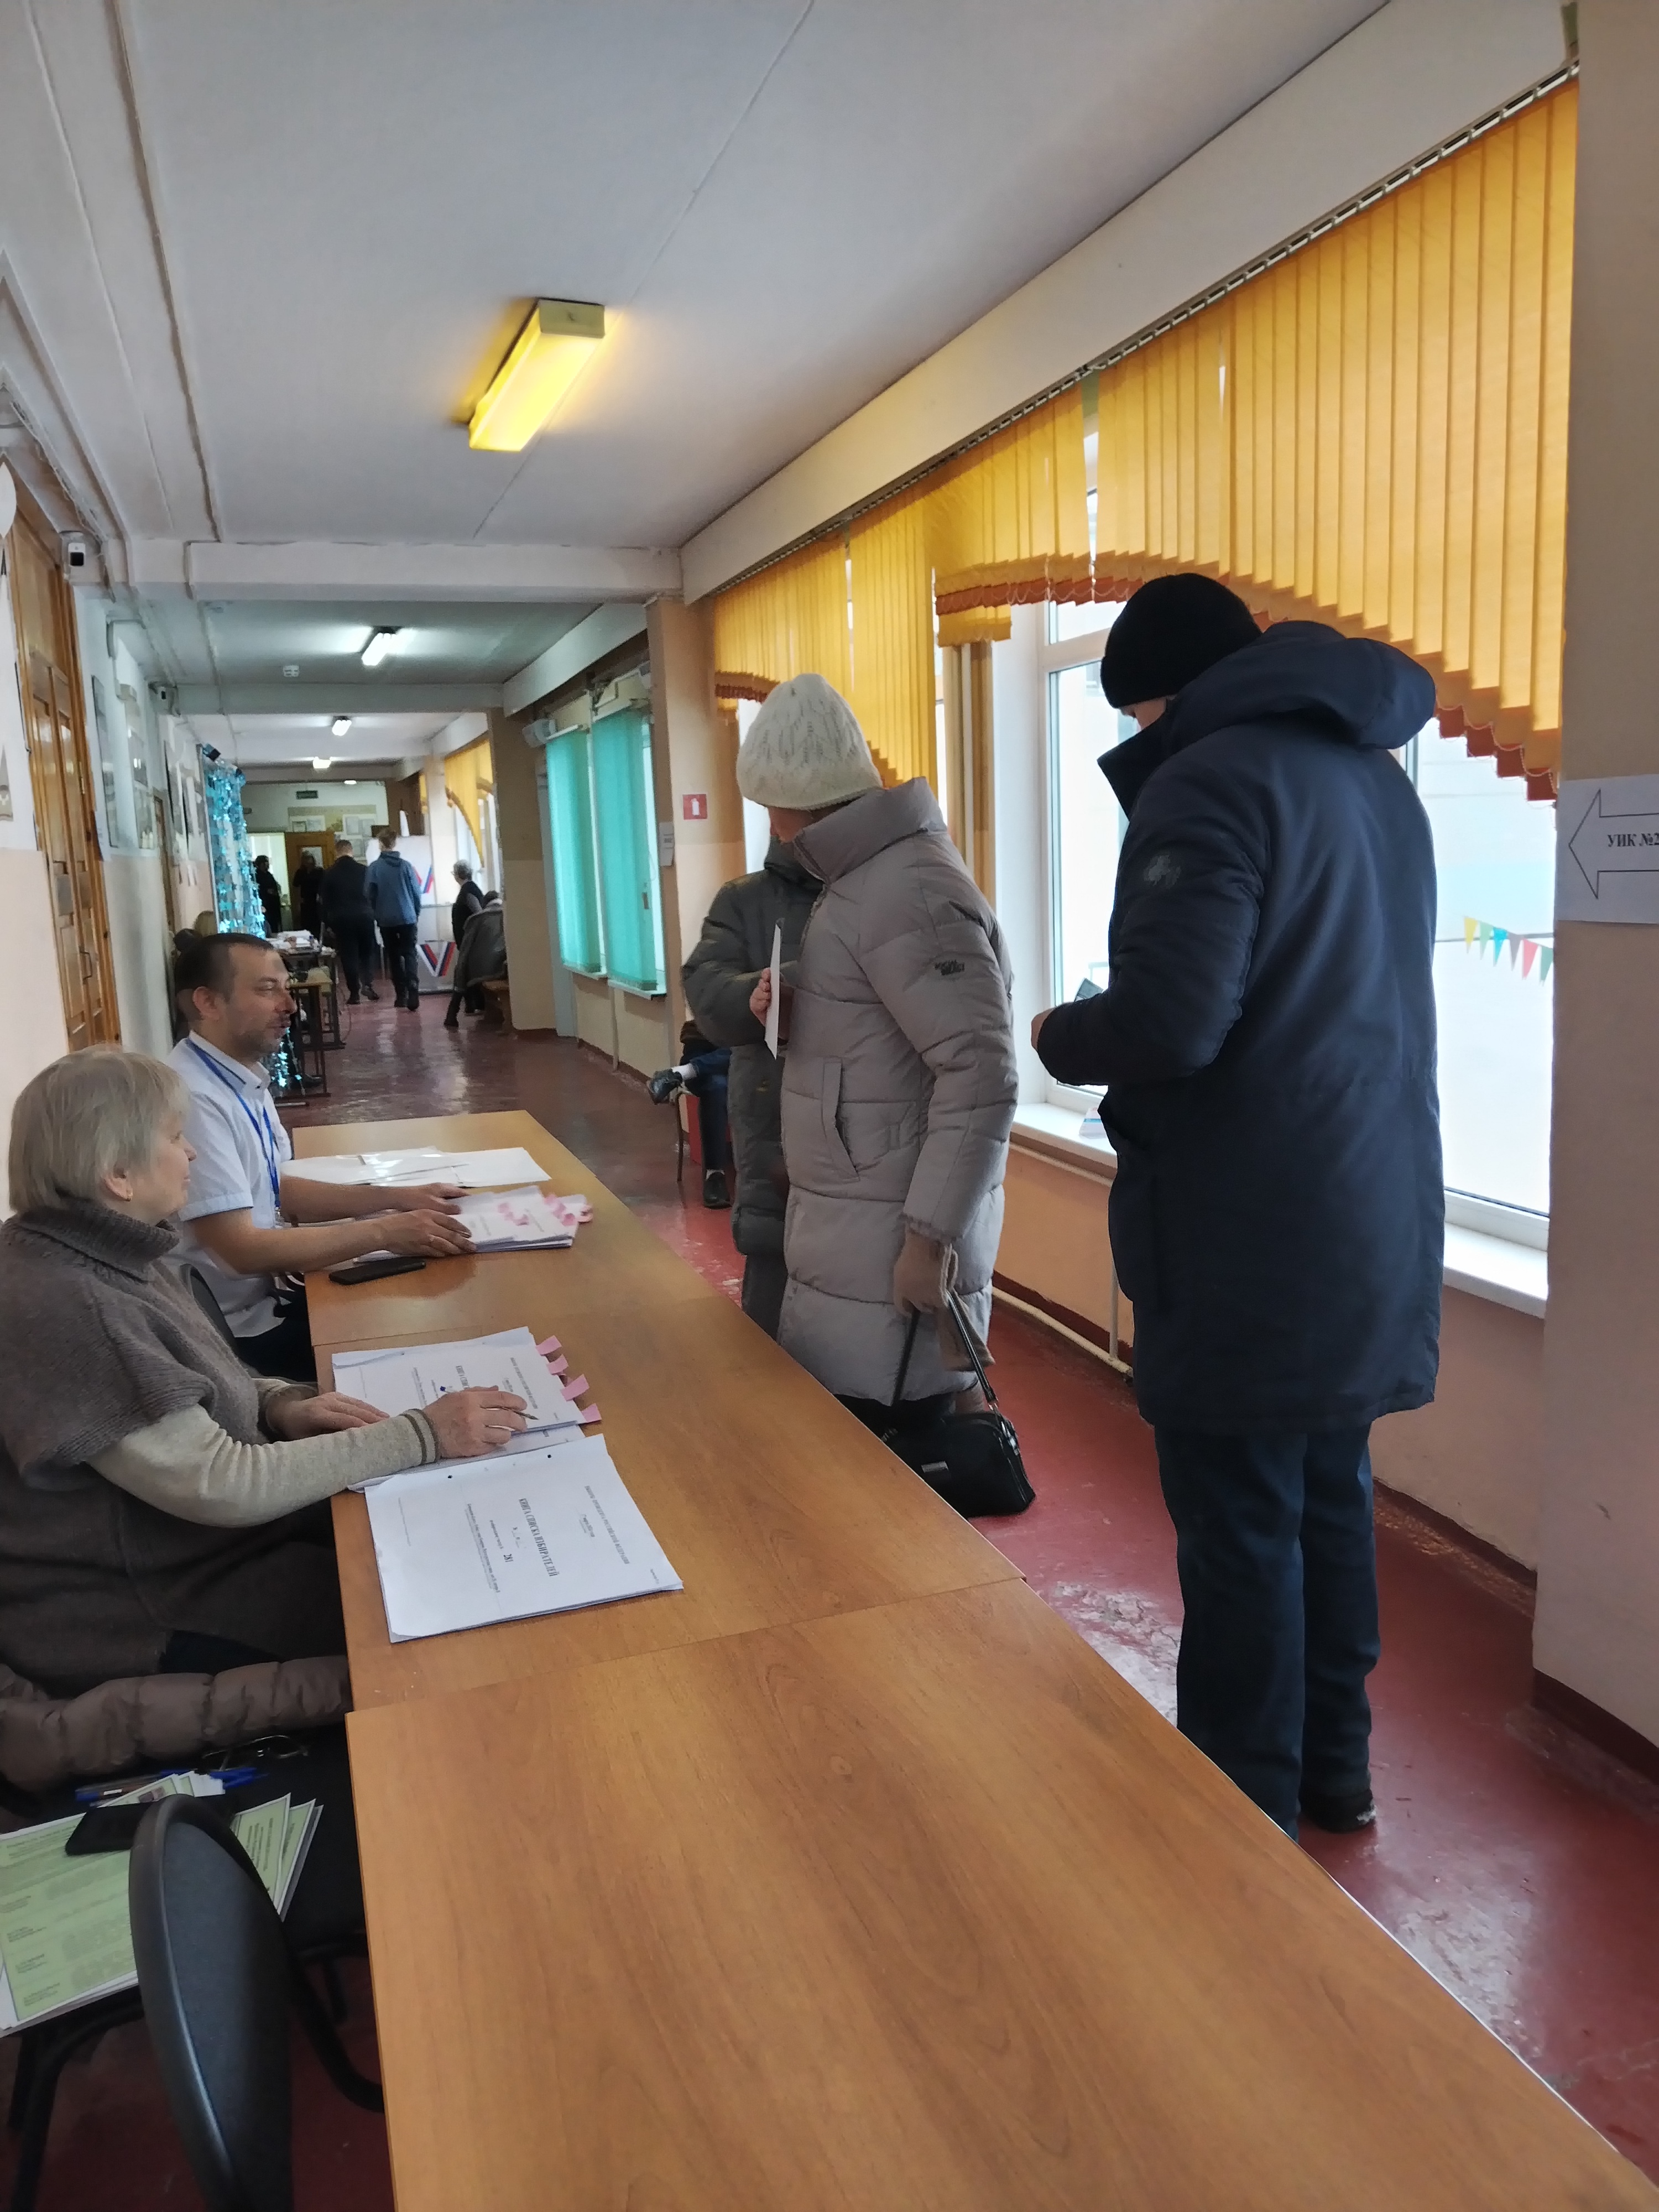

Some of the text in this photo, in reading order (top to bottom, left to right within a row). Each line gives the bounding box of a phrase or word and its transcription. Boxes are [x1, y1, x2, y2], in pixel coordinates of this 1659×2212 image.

[1607, 833, 1637, 848] УИК
[518, 1498, 560, 1577] КНИГА СПИСКА ИЗБИРАТЕЛЕЙ
[503, 1553, 514, 1562] 281
